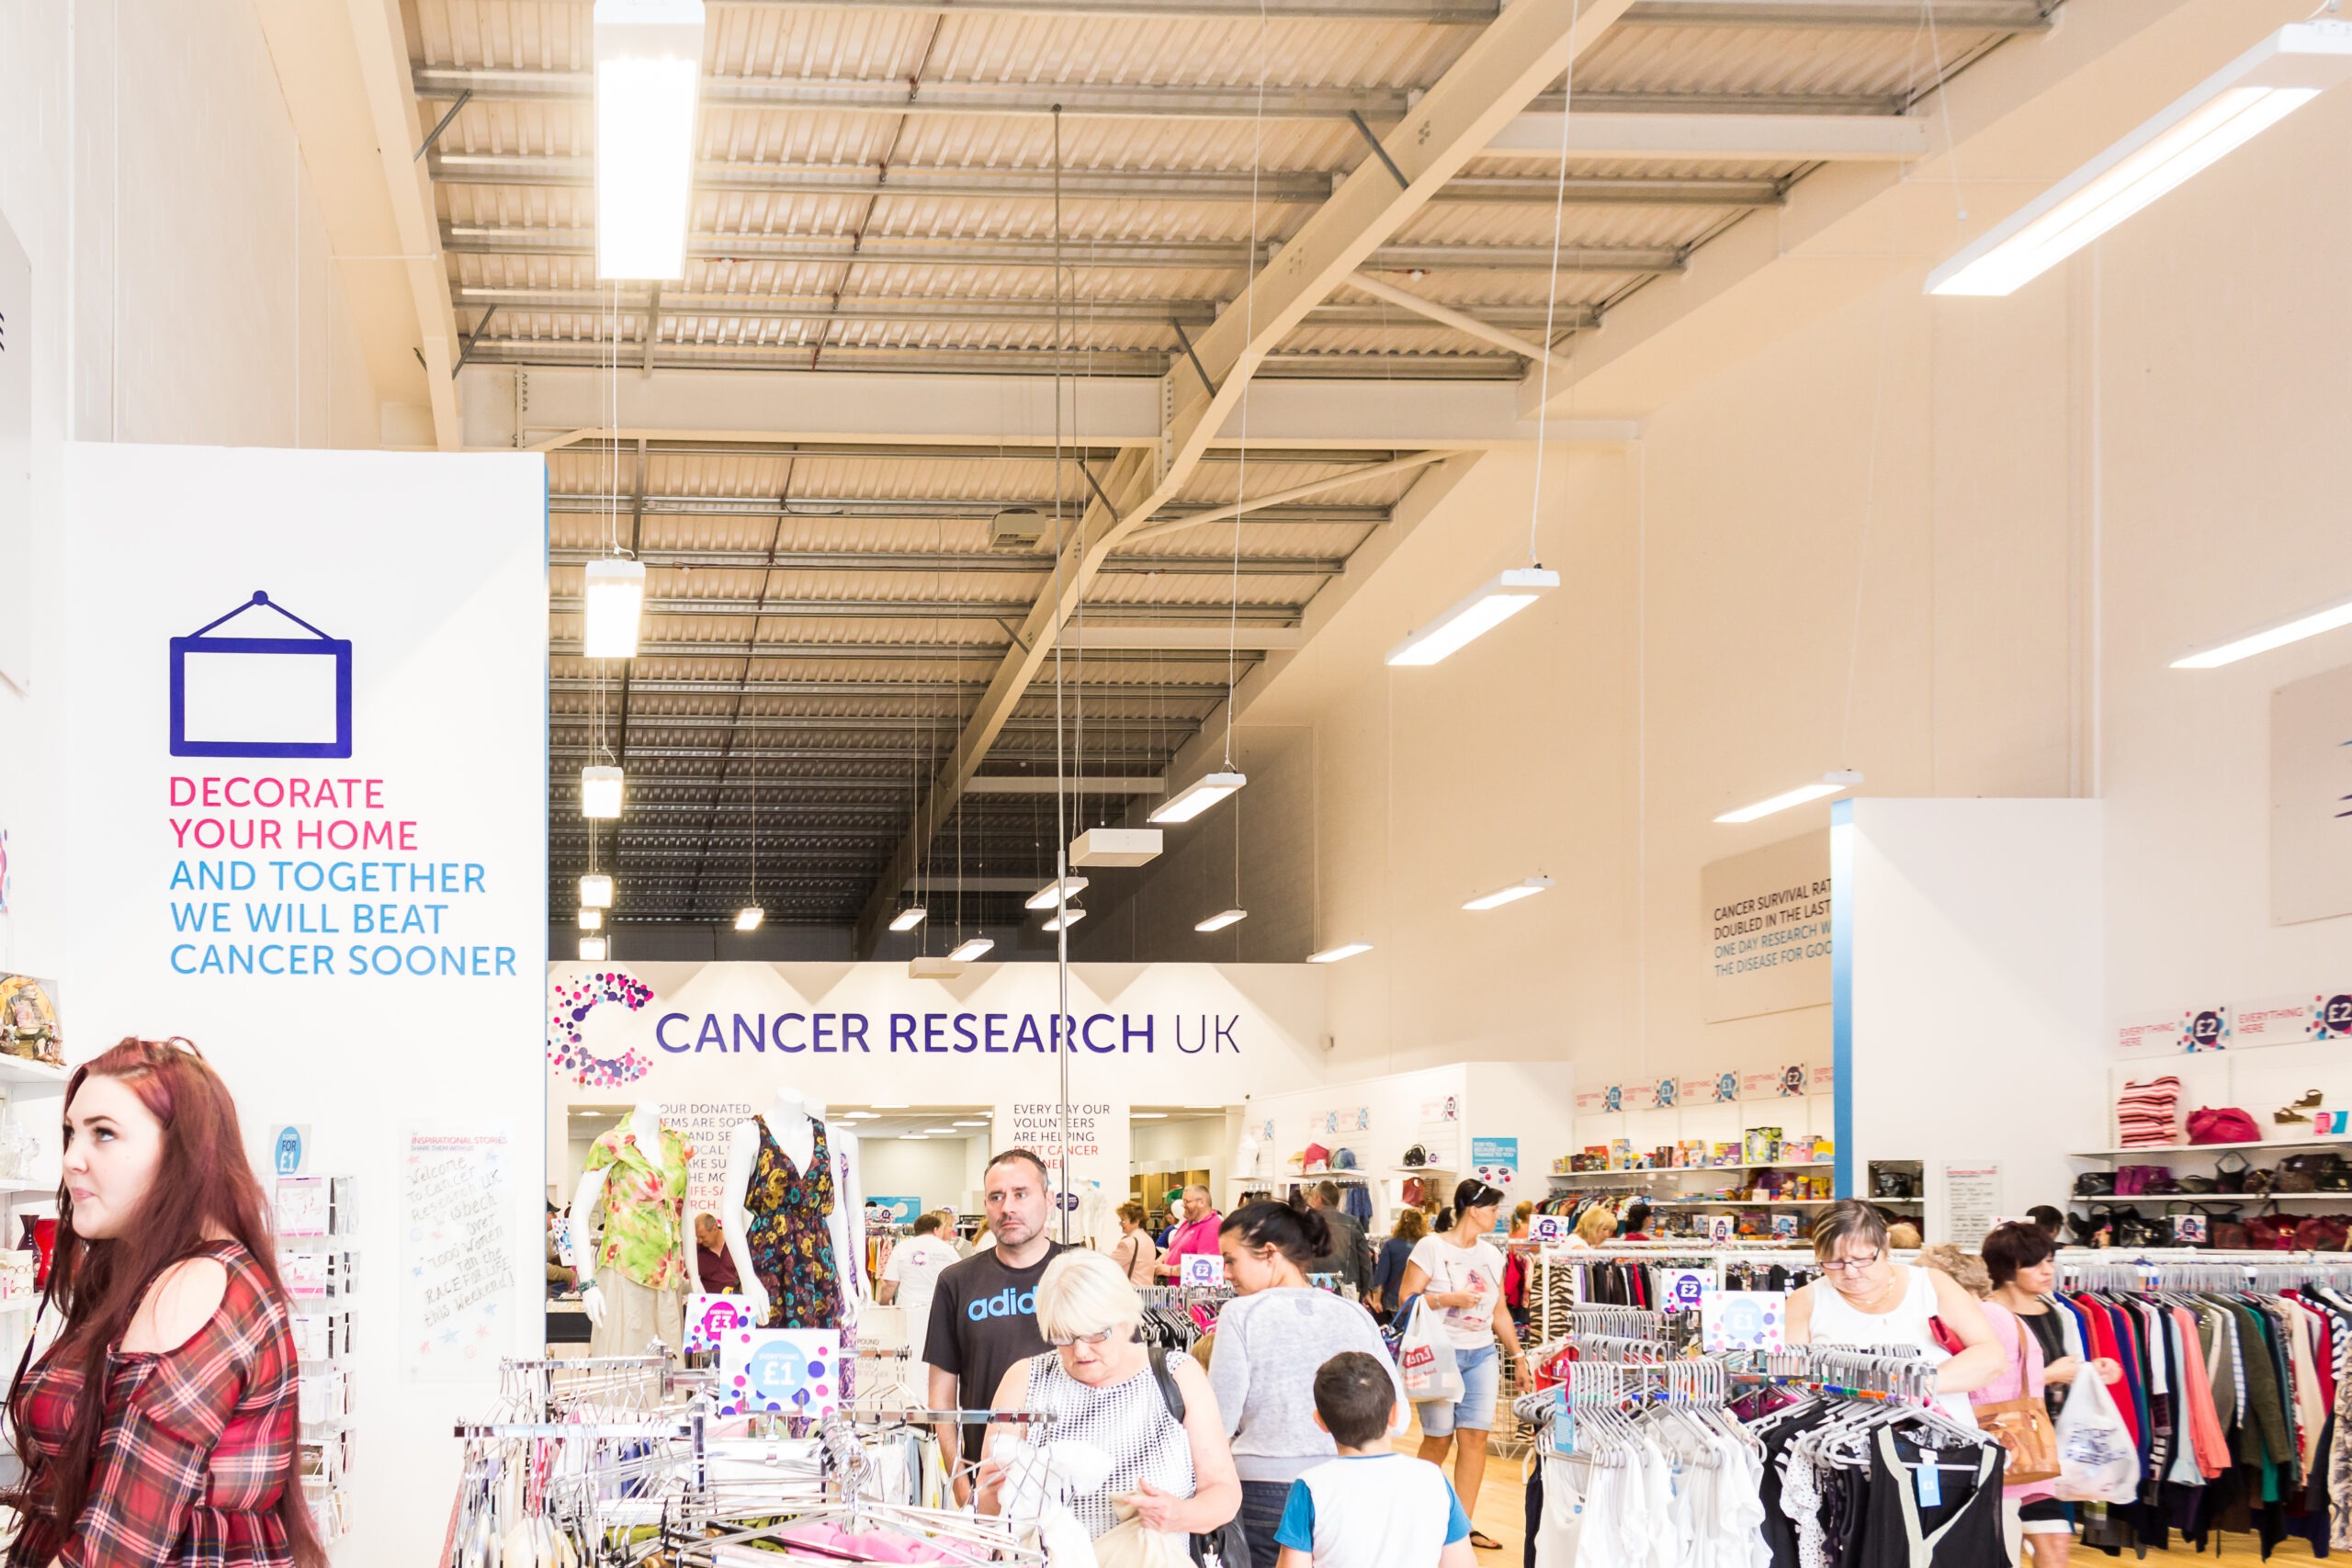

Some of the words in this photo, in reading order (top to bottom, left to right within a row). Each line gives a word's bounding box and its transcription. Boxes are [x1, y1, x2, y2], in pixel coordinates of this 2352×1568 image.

[170, 777, 384, 808] DECORATE
[169, 818, 282, 850] YOUR
[298, 820, 418, 851] HOME
[170, 861, 256, 891] AND
[269, 861, 486, 893] TOGETHER
[1713, 899, 1755, 921] CANCER
[1757, 885, 1809, 910] SURVIVAL
[1812, 878, 1831, 897] RAT
[171, 902, 232, 932] WE
[245, 903, 340, 933] WILL
[353, 904, 448, 934] BEAT
[1713, 917, 1763, 941] DOUBLED
[1765, 913, 1777, 928] IN
[1780, 907, 1801, 924] THE
[1804, 898, 1831, 919] LAST
[1714, 942, 1736, 959] ONE
[1738, 935, 1758, 954] DAY
[1761, 923, 1817, 947] RESEARCH
[170, 944, 334, 976] CANCER
[348, 945, 517, 976] SOONER
[1714, 963, 1734, 977] THE
[1736, 952, 1778, 974] DISEASE
[1781, 947, 1803, 964] FOR
[1805, 941, 1832, 958] GOO
[2238, 1007, 2304, 1023] EVERYTHING
[2326, 1003, 2352, 1022] £2
[655, 1012, 870, 1054] CANCER
[890, 1012, 1154, 1054] RESEARCH
[1175, 1013, 1240, 1054] UK
[2119, 1022, 2176, 1038] EVERYTHING
[2196, 1019, 2217, 1037] £2
[2239, 1023, 2265, 1034] HERE
[2120, 1037, 2142, 1047] HERE
[691, 1103, 752, 1114] DONATED
[1013, 1104, 1052, 1114] EVERY
[1056, 1104, 1079, 1114] DAY
[1082, 1104, 1110, 1114] OUR
[692, 1118, 716, 1128] ARE
[281, 1140, 297, 1152] FOR
[412, 1136, 471, 1145] INSPIRATIONAL
[474, 1136, 507, 1145] STORIES
[688, 1132, 714, 1142] AND
[718, 1132, 731, 1142] SE
[1013, 1132, 1036, 1142] ARE
[1041, 1132, 1094, 1142] HELPING
[694, 1145, 725, 1156] OCAL
[1047, 1145, 1098, 1155] CANCER
[278, 1151, 295, 1173] £1
[406, 1156, 468, 1185] Welcome
[711, 1159, 727, 1169] SU
[481, 1168, 503, 1189] UK
[689, 1173, 705, 1182] HE
[483, 1247, 503, 1264] the
[424, 1277, 461, 1304] RACE
[461, 1269, 482, 1289] FOR
[483, 1256, 512, 1278] LIFE
[1196, 1267, 1209, 1277] £2
[1680, 1284, 1698, 1297] £2
[967, 1286, 1039, 1322] adid
[424, 1304, 450, 1327] this
[710, 1315, 731, 1332] £3
[1734, 1314, 1755, 1330] £1
[763, 1361, 795, 1385] £1
